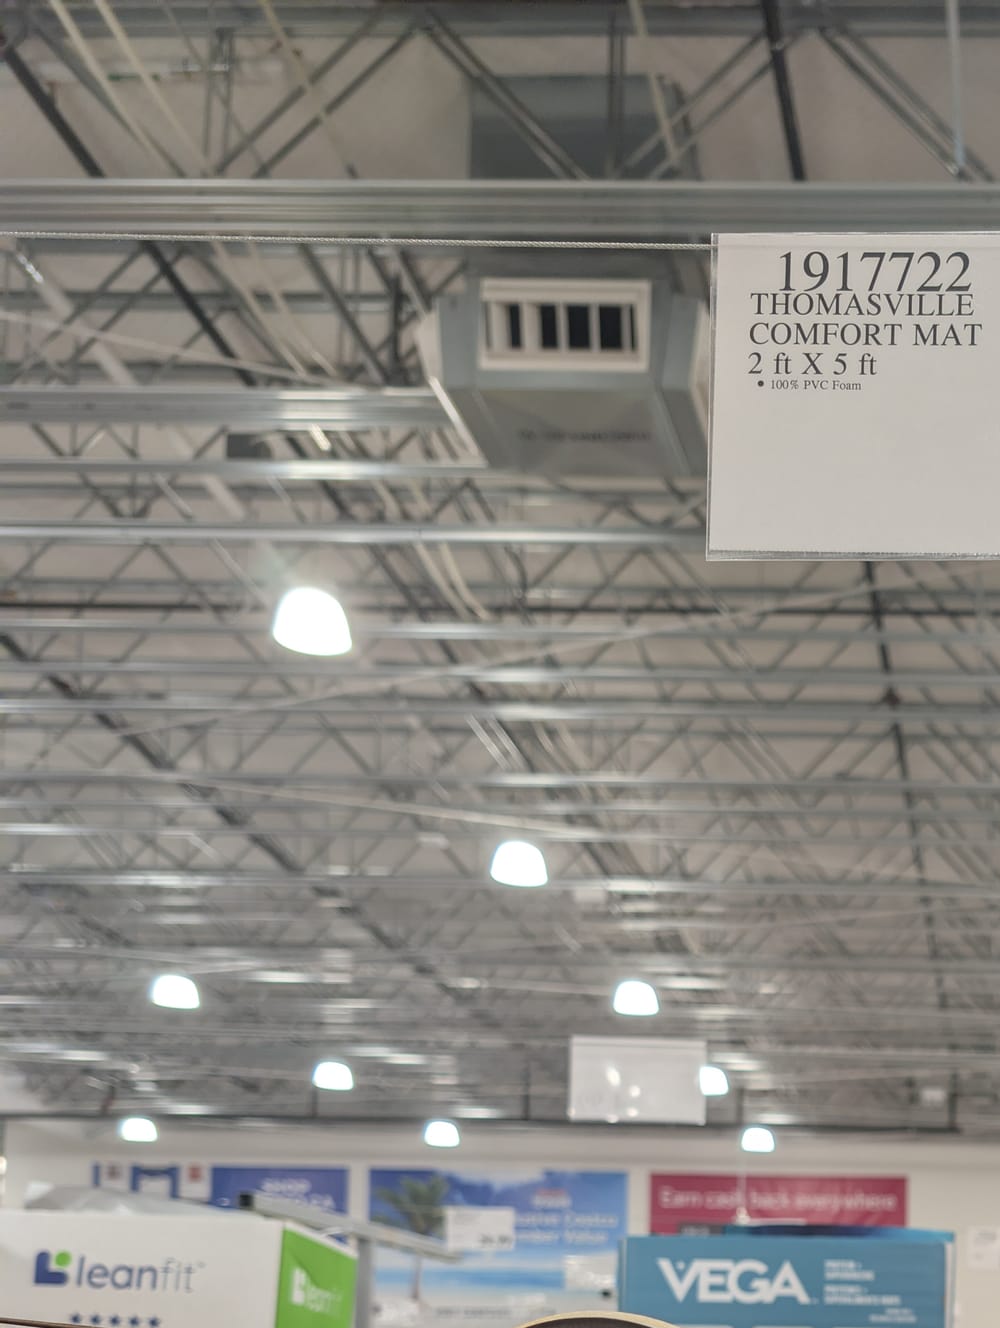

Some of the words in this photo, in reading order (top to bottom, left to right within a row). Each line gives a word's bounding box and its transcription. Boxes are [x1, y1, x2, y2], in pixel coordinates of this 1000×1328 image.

[779, 251, 972, 292] 1917722
[751, 293, 975, 316] THOMASVILLE
[750, 322, 902, 346] COMFORT
[912, 323, 983, 347] MAT
[748, 352, 762, 375] 2
[773, 352, 792, 375] ft
[801, 352, 824, 375] X
[833, 352, 847, 376] 5
[858, 353, 878, 376] ft
[770, 379, 799, 390] 100%
[803, 379, 829, 390] PVC
[832, 380, 862, 391] Foam
[76, 1254, 194, 1294] leanfit
[656, 1257, 811, 1305] VEGA
